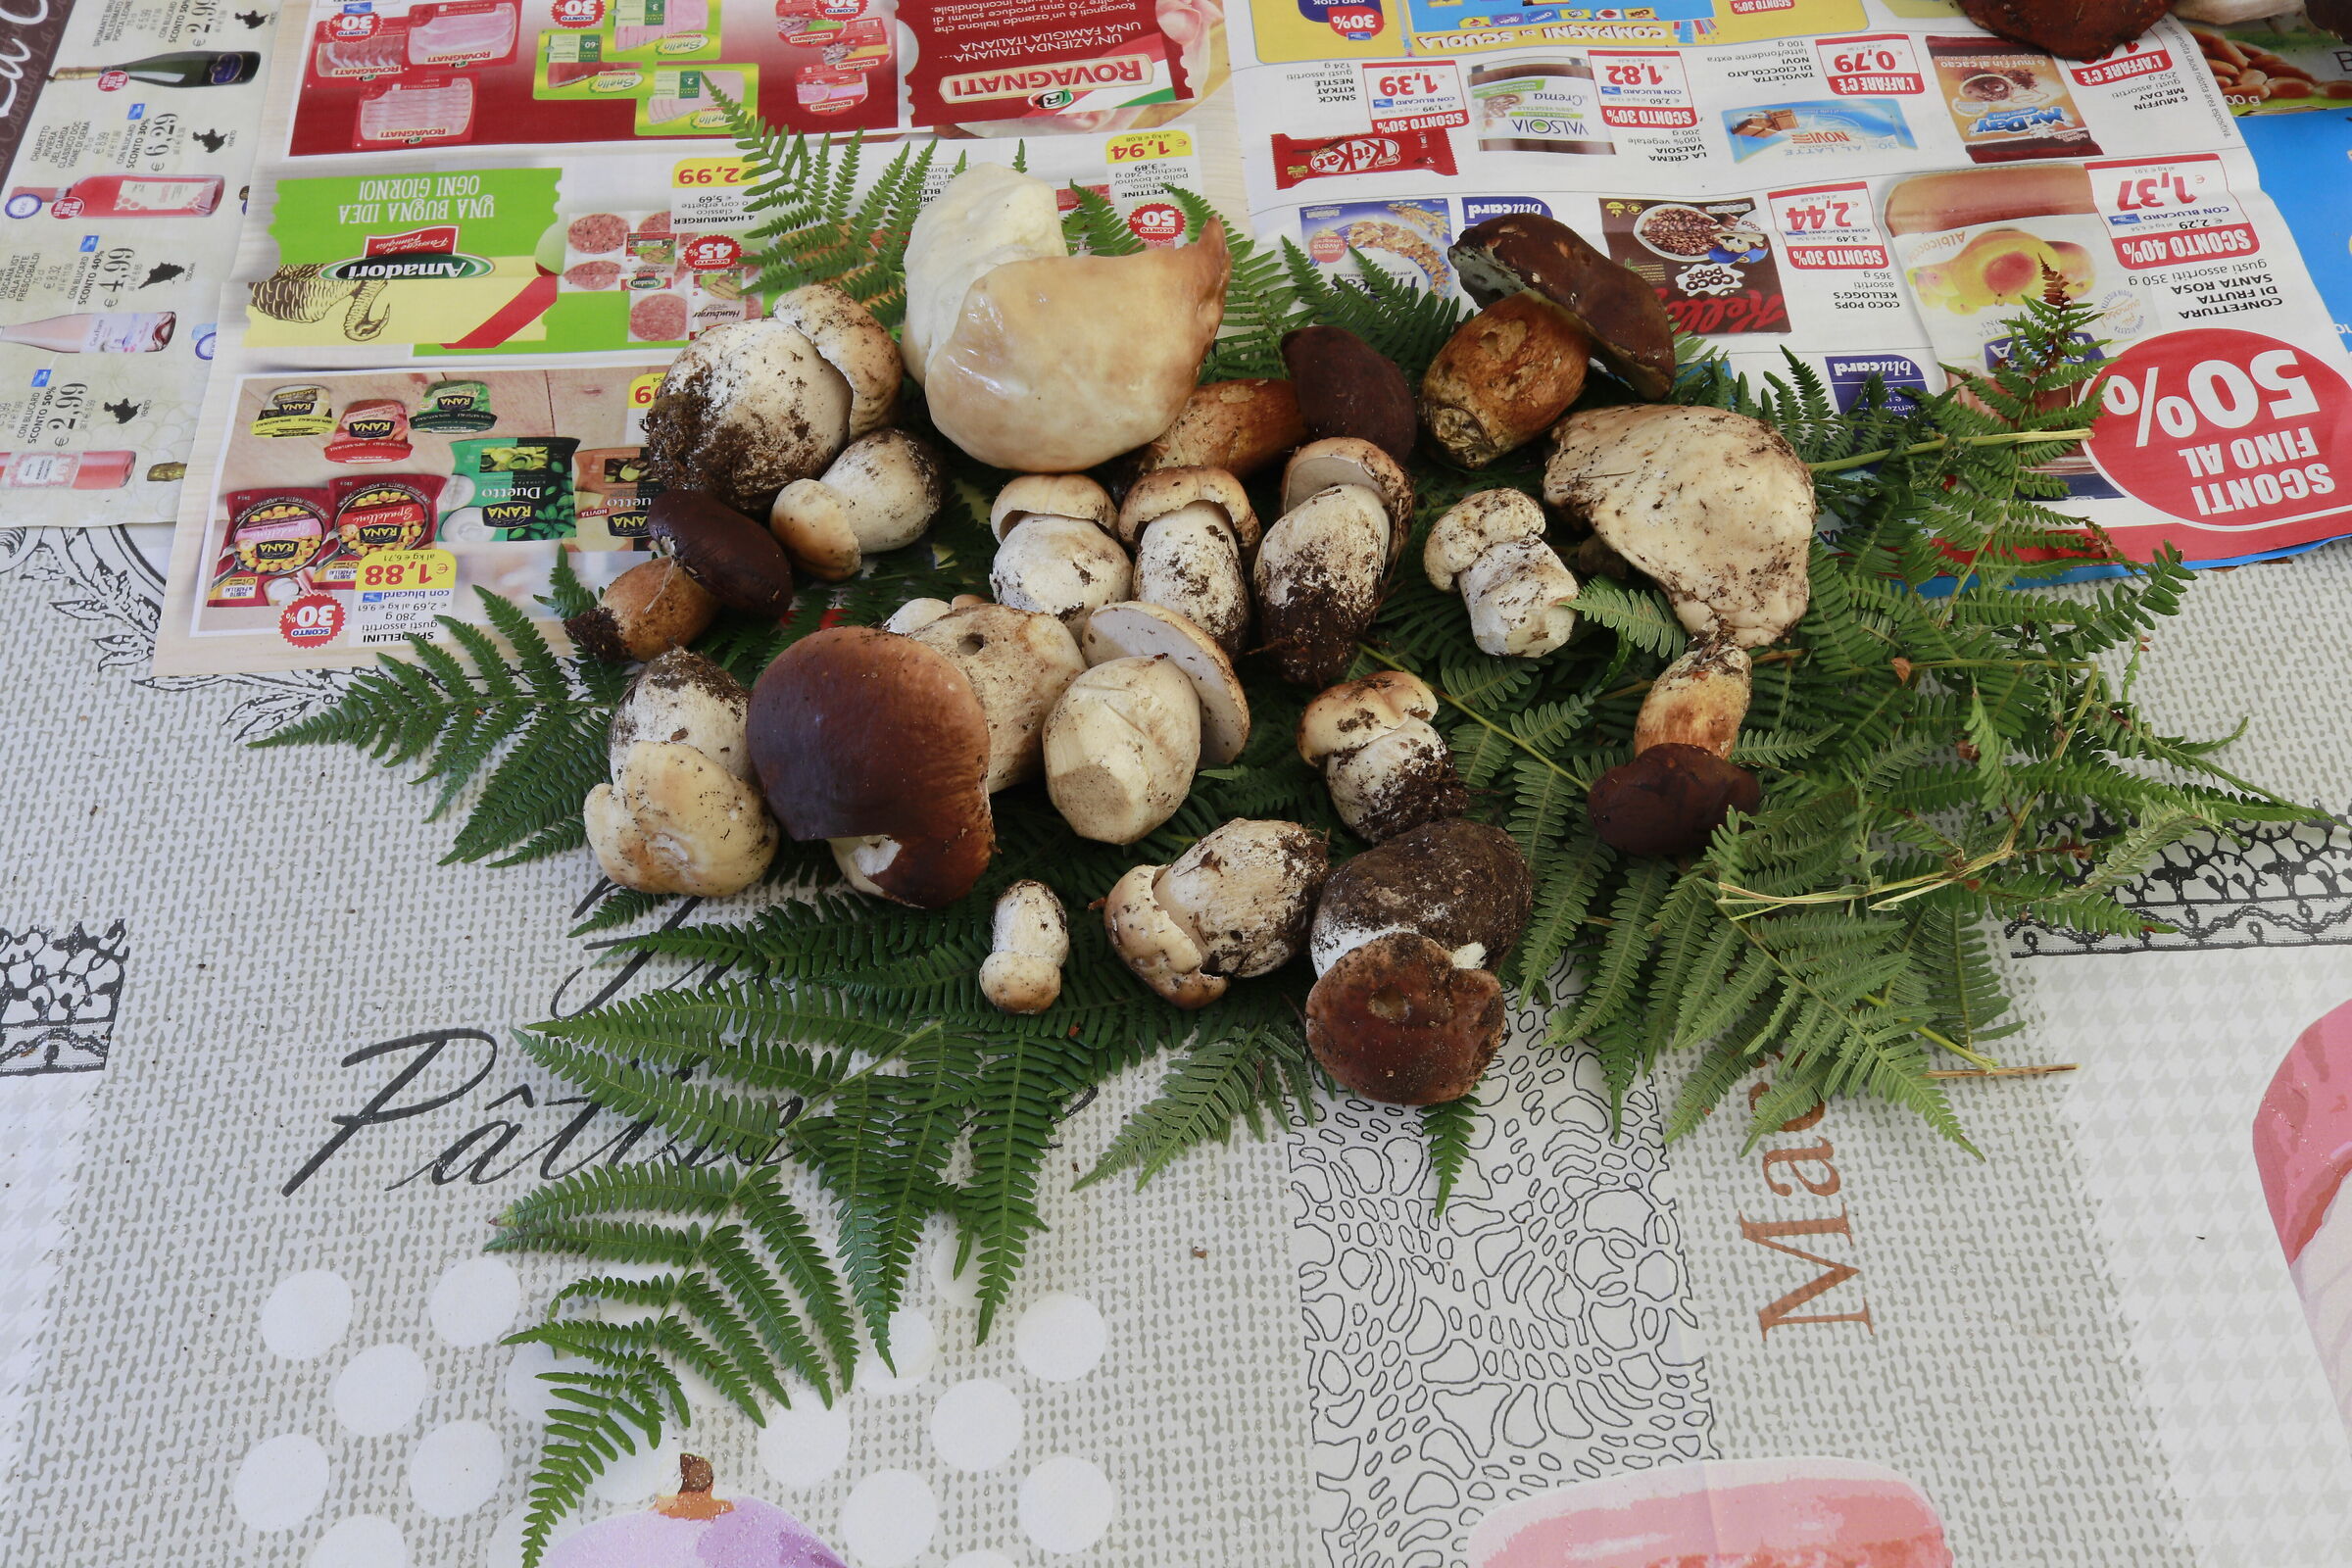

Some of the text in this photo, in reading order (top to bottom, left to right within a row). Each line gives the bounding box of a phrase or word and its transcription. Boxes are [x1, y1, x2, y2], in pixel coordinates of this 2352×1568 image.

[947, 2, 1065, 24] anni produce salumi
[1080, 2, 1137, 17] Rovagnati
[332, 16, 373, 30] 30%
[951, 20, 1000, 31] italiana
[1003, 12, 1066, 26] un'azienda
[1333, 14, 1376, 29] 30%
[169, 15, 185, 43] SCONTO
[958, 22, 1142, 51] UNA FAMIGLIA ITALIANA
[1417, 24, 1665, 49] COMPAGNI SCUOLA
[939, 33, 1123, 63] UN'AZIENDA ITALIANA...
[1734, 48, 1807, 61] latte/fondente
[426, 51, 491, 63] ROVAGNATI
[838, 60, 877, 70] ROVAGNATI
[1834, 49, 1896, 74] 0,79
[335, 66, 399, 75] ROVAGNATI
[1605, 63, 1663, 85] 1,82
[1728, 66, 1796, 77] CIOCCOLATO
[2102, 55, 2163, 79] L'AFFARE
[952, 59, 1144, 97] ROVAGNATI
[1286, 72, 1326, 80] assortiti
[1314, 78, 1353, 87] NESTLÉ
[1753, 73, 1815, 83] TAVOLETTA
[1862, 76, 1916, 90] L'AFFARE
[2159, 72, 2177, 80] 252
[1379, 73, 1439, 97] 1,39
[2111, 78, 2180, 99] gusti assortiti
[1318, 94, 1356, 103] SNACK
[2138, 87, 2184, 101] MR.DAY
[812, 100, 852, 110] ROVAGNATI
[2133, 97, 2178, 111] MUFFIN
[1377, 113, 1464, 134] SCONTO 30%
[1606, 110, 1692, 124] SCONTO 30%
[380, 128, 446, 137] ROVAGNATI
[1511, 120, 1589, 134] VALSOIA
[29, 125, 50, 162] CHIARETTO
[42, 131, 59, 157] RIVIERA
[55, 125, 70, 149] GARDA
[126, 118, 150, 169] SCONTO 30%
[144, 113, 178, 172] € 6,29
[58, 136, 75, 169] CLASSICO
[1110, 139, 1170, 160] 1,94
[1317, 140, 1388, 172] KitKat
[1655, 144, 1705, 154] VALSOIA
[678, 166, 740, 184] 2,99
[1134, 163, 1157, 172] 3,89
[437, 175, 480, 196] OGNI
[2117, 172, 2197, 211] 1,37
[337, 195, 495, 224] UNA BUONA IDEA
[681, 202, 718, 211] erbette
[1786, 200, 1851, 230] 2,44
[2143, 206, 2230, 220] CON BLUCARD
[673, 215, 745, 225] HAMBURGER
[1132, 210, 1176, 226] 50%
[2179, 219, 2210, 229] 2,29
[375, 234, 421, 251] Famiglia
[401, 236, 449, 250] Passione
[2122, 228, 2252, 264] SCONTO 40%
[689, 242, 733, 261] 45%
[1792, 249, 1884, 266] SCONTO 30%
[8, 256, 29, 299] CALA FORTE
[17, 253, 40, 302] FRESCOBALDI
[73, 257, 88, 284] BLUCARD
[77, 250, 105, 305] SCONTO 40%
[98, 248, 134, 308] € 4,99
[347, 261, 467, 280] Amadori
[2128, 259, 2268, 286] gusti assortiti 350 g
[632, 278, 661, 287] Amadori
[2170, 274, 2273, 295] SANTA ROSA
[2196, 286, 2278, 306] DI FRUTTA
[692, 309, 741, 319] Hamburger
[2178, 297, 2283, 319] CONFETTURA
[23, 392, 40, 422] BLUCARD
[281, 403, 312, 412] RANA
[439, 397, 470, 407] RANA
[2101, 350, 2321, 448] 50%
[27, 386, 57, 444] SCONTO 50%
[47, 383, 87, 447] € 2,99
[352, 421, 390, 432] RANA
[2178, 426, 2319, 477] FINO AL
[481, 486, 540, 499] Duetto
[2191, 463, 2335, 515] SCONTI
[352, 507, 414, 524] Spadellini
[487, 506, 531, 518] RANA
[362, 525, 399, 537] RANA
[259, 541, 295, 553] RANA
[364, 562, 433, 585] 1,88
[383, 591, 426, 600] blucard
[413, 602, 438, 611] 2,69
[285, 609, 335, 627] 30%
[395, 612, 416, 621] 280
[362, 620, 438, 632] gusti assortiti
